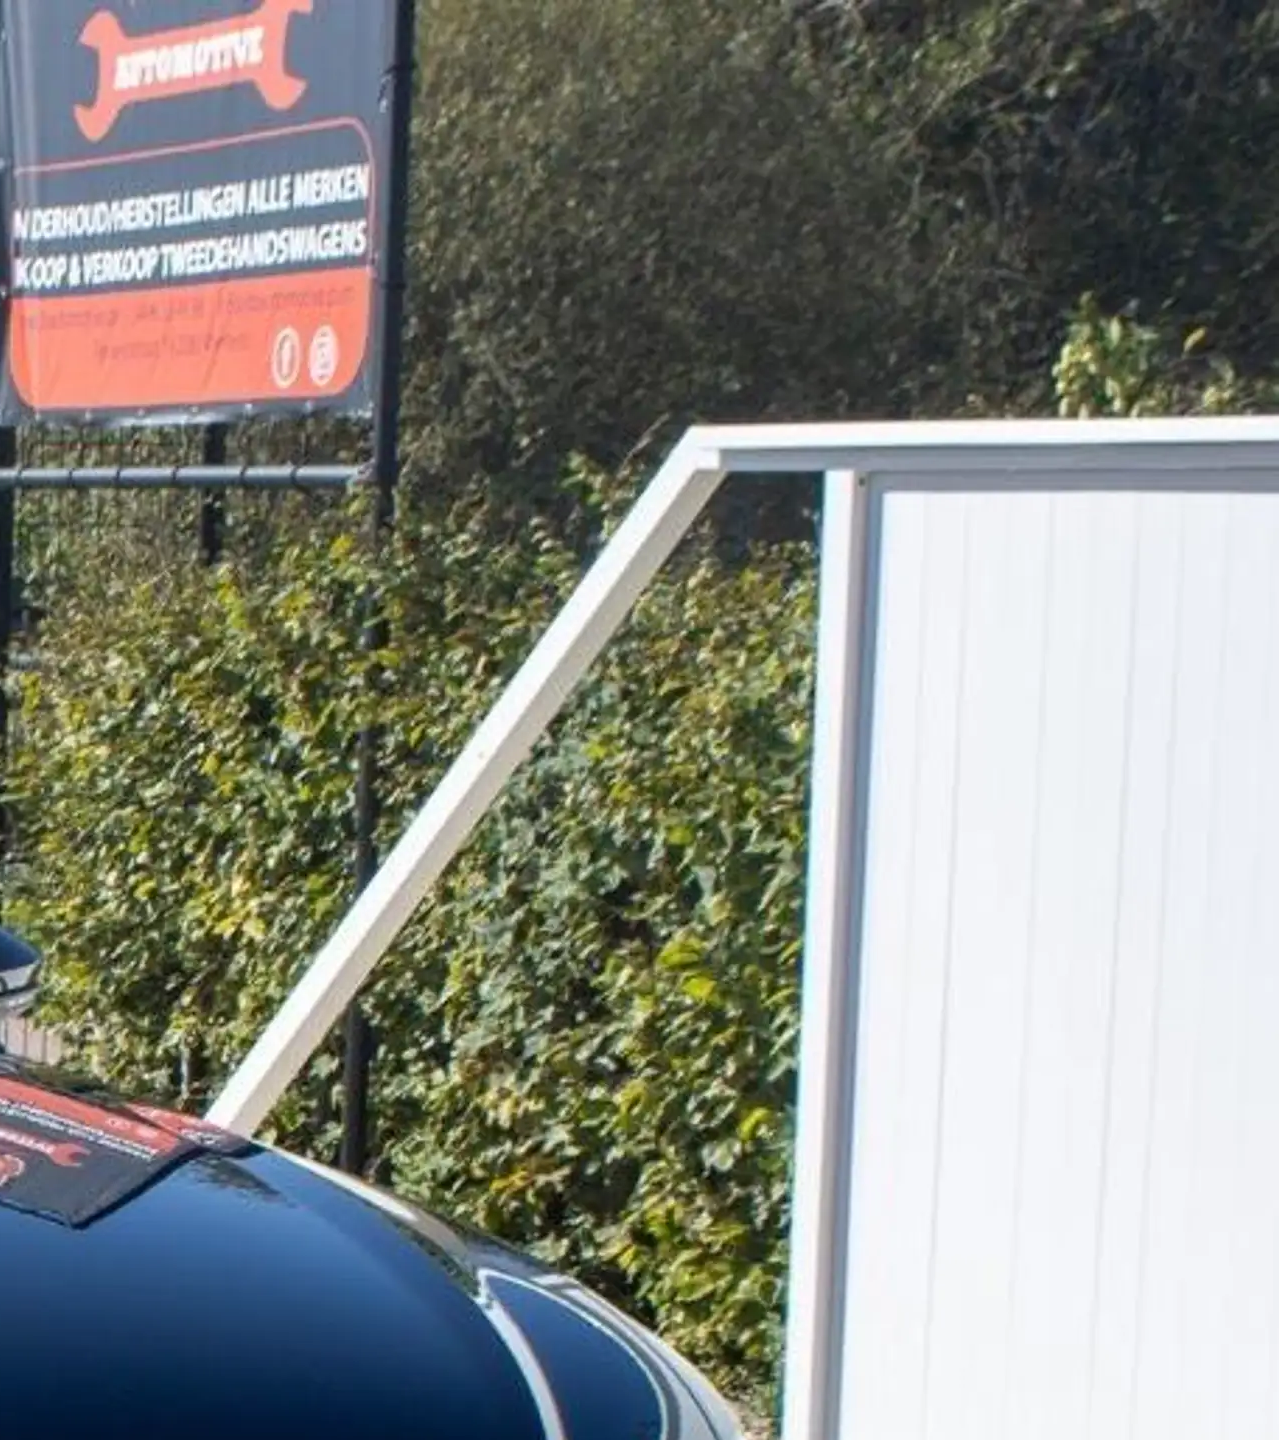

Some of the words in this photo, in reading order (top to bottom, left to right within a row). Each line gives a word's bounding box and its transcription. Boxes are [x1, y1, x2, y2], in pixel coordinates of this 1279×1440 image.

[113, 26, 265, 91] AUTOMOTIVE
[247, 173, 291, 215] ALLE
[293, 162, 370, 208] MERKEN
[82, 244, 160, 287] VERKOOP
[160, 219, 368, 279] TWEEDEHANDSWAGENS
